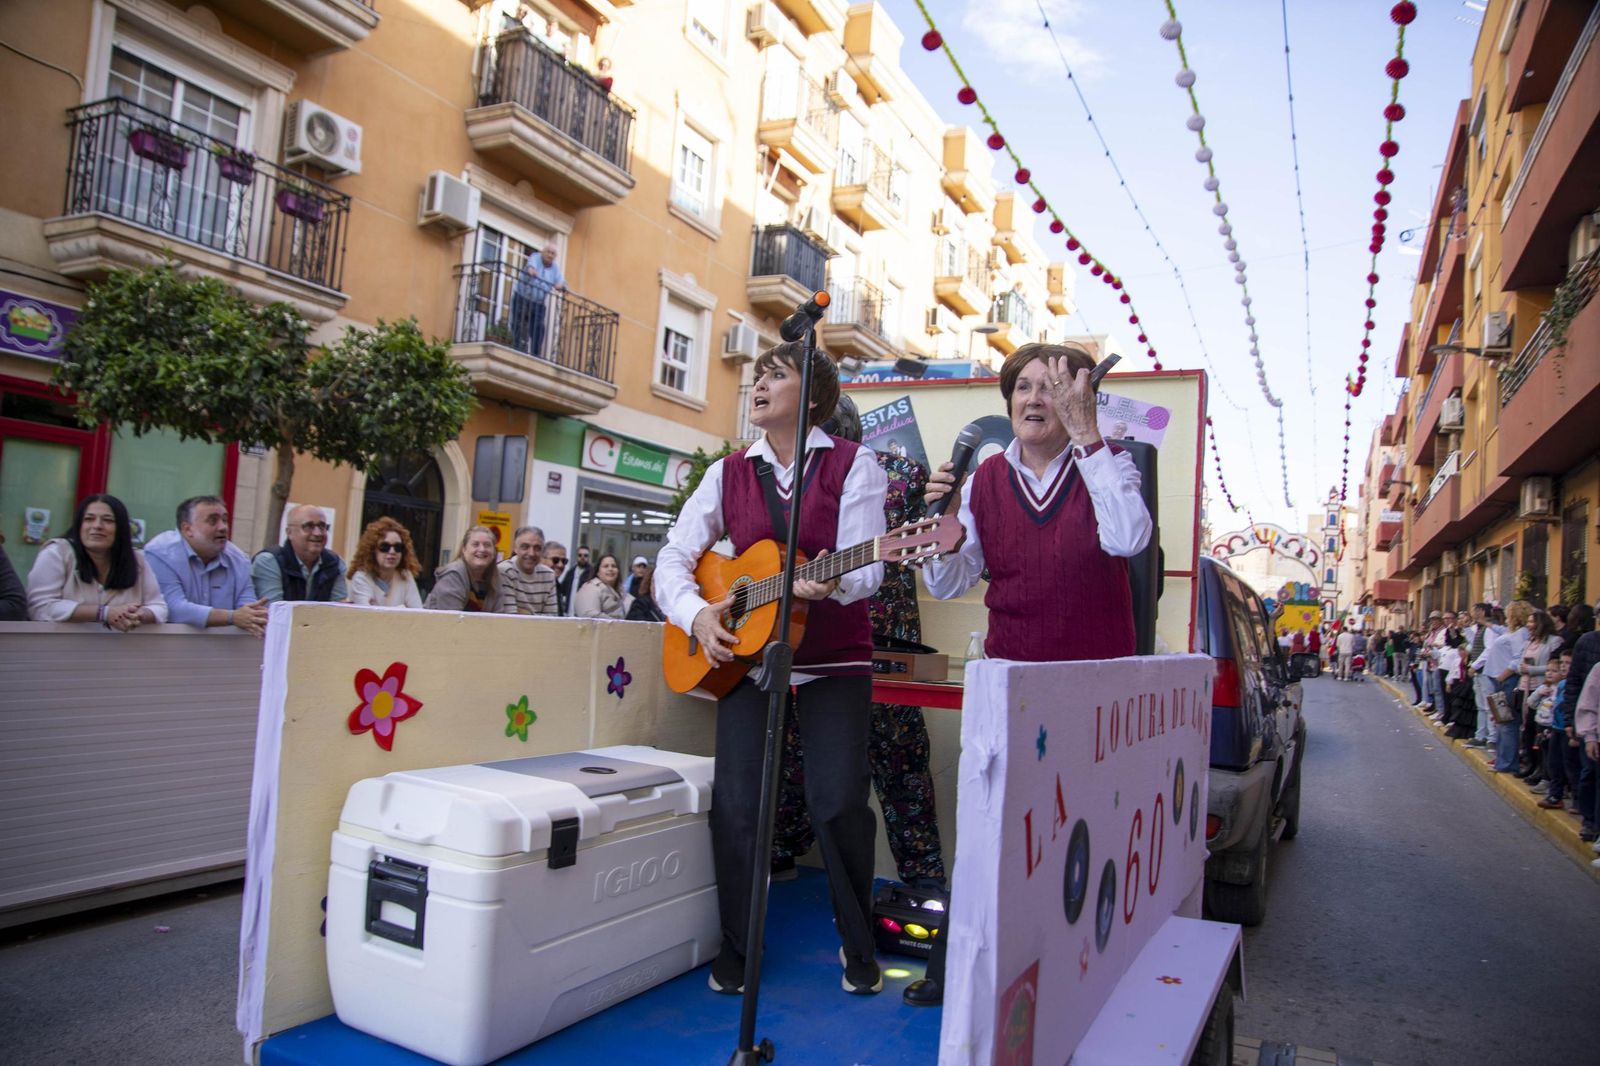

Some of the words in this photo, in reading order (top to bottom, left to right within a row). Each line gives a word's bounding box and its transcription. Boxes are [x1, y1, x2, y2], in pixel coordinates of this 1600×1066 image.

[860, 399, 909, 430] ESTAS
[862, 415, 914, 442] nahadux
[1095, 693, 1165, 763] LOCURA
[1171, 687, 1187, 729] DE
[592, 850, 681, 904] IGLOO
[1124, 792, 1164, 925] 60
